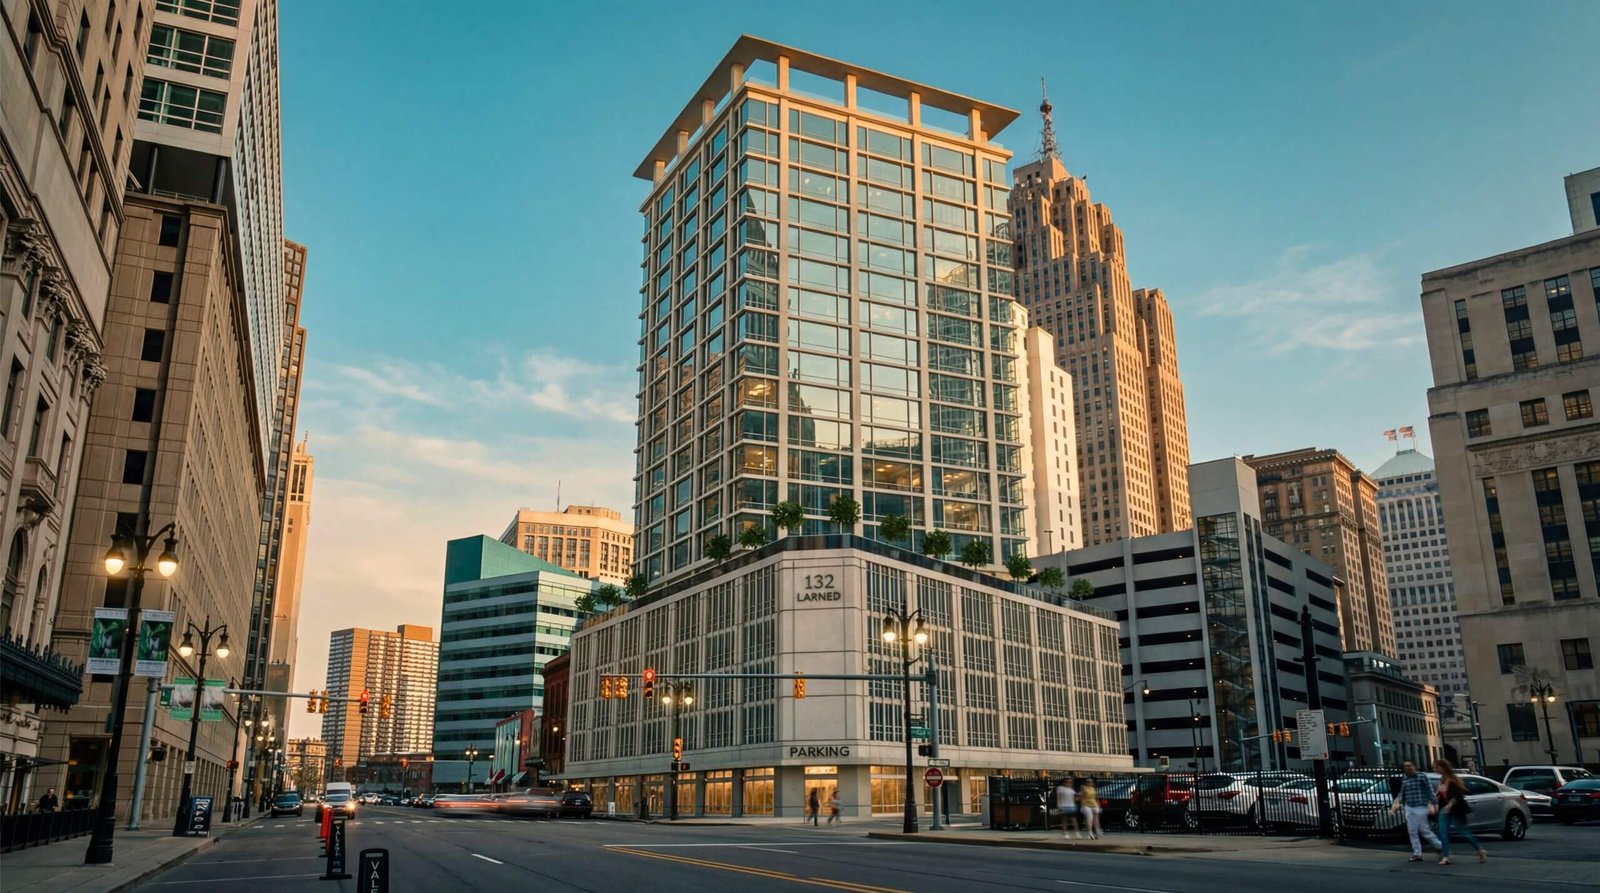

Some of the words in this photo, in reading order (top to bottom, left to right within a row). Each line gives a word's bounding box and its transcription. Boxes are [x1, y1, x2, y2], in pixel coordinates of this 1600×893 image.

[805, 574, 835, 590] 132
[797, 592, 841, 602] LARNED
[790, 746, 850, 757] PARKING
